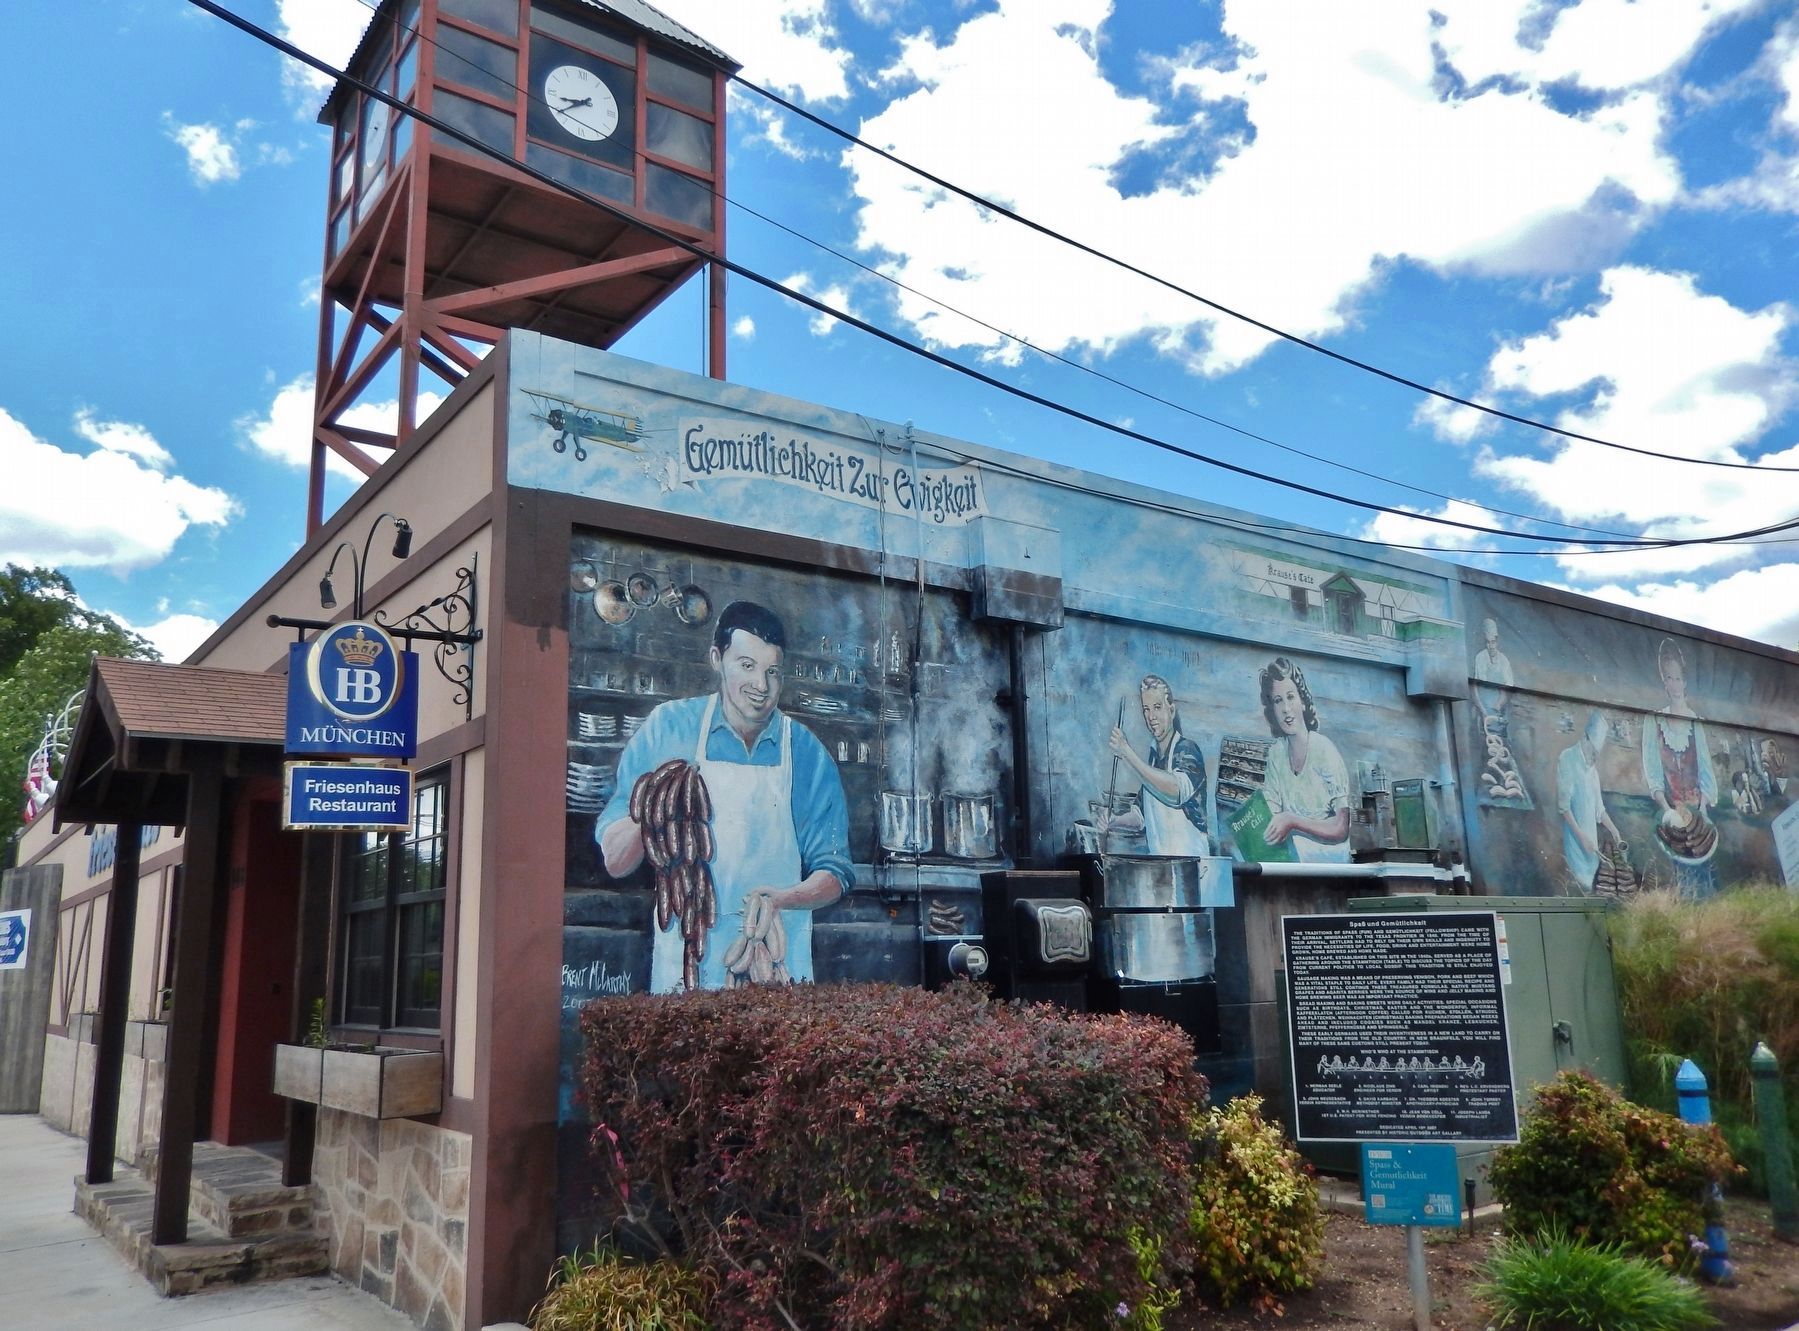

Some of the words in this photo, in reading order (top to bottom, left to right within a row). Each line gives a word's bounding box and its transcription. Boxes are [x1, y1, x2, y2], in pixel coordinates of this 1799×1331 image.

[685, 424, 844, 492] Gemütlichkeit
[848, 456, 889, 504] Zur
[335, 667, 383, 704] HB
[300, 725, 406, 748] MÜNCHEN
[304, 779, 401, 795] Friesenhaus
[309, 797, 397, 813] Restaurant
[561, 964, 588, 988] BRENT
[1370, 1180, 1395, 1189] Mural
